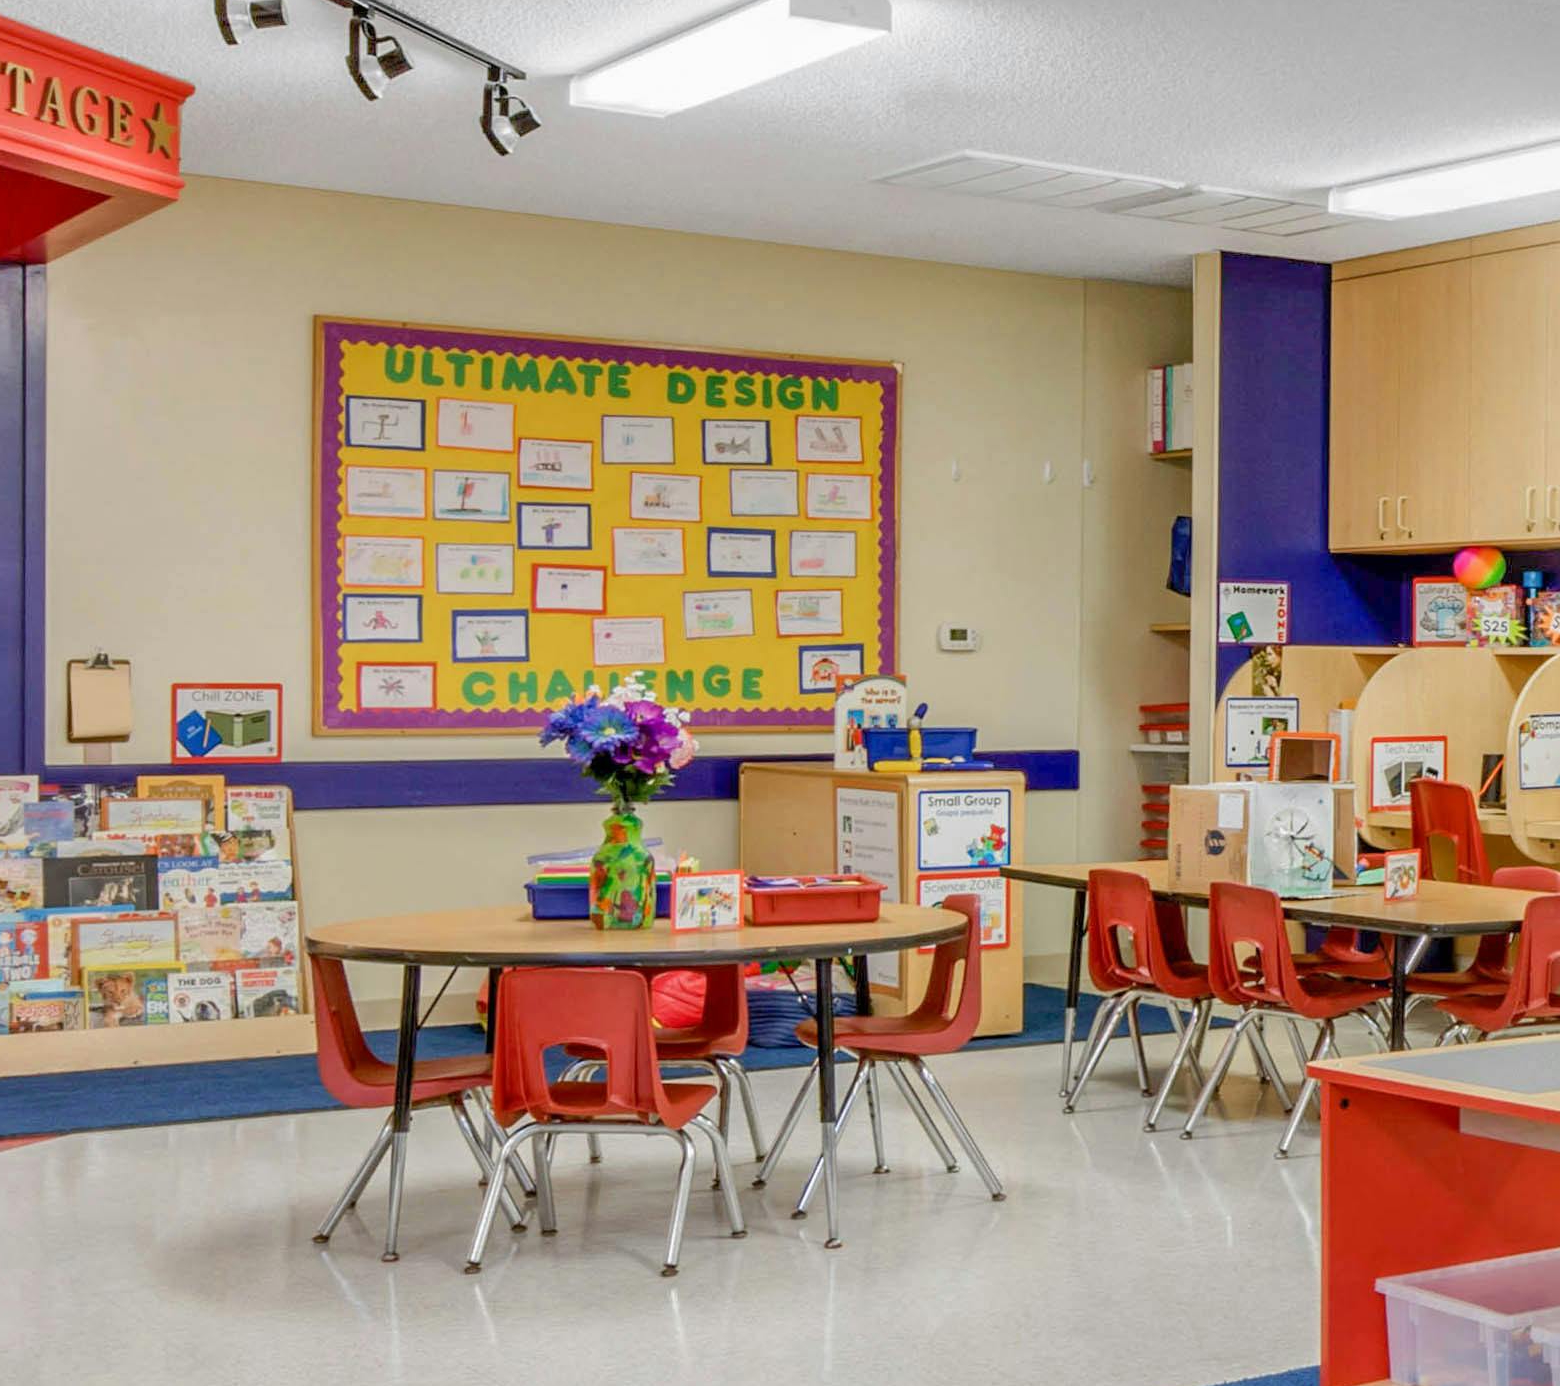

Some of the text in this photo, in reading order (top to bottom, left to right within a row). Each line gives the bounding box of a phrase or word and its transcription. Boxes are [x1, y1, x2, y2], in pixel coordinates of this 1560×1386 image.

[384, 347, 842, 412] ULTIMATE DESIGN
[1233, 585, 1285, 595] Homework
[1276, 597, 1286, 642] ZONE
[1483, 620, 1508, 632] $25
[192, 690, 265, 703] Chill ZONE
[1384, 744, 1435, 754] Tech ZONE
[927, 795, 1002, 809] Small Group
[923, 879, 1002, 894] Science ZONE
[178, 978, 221, 987] THE DOG
